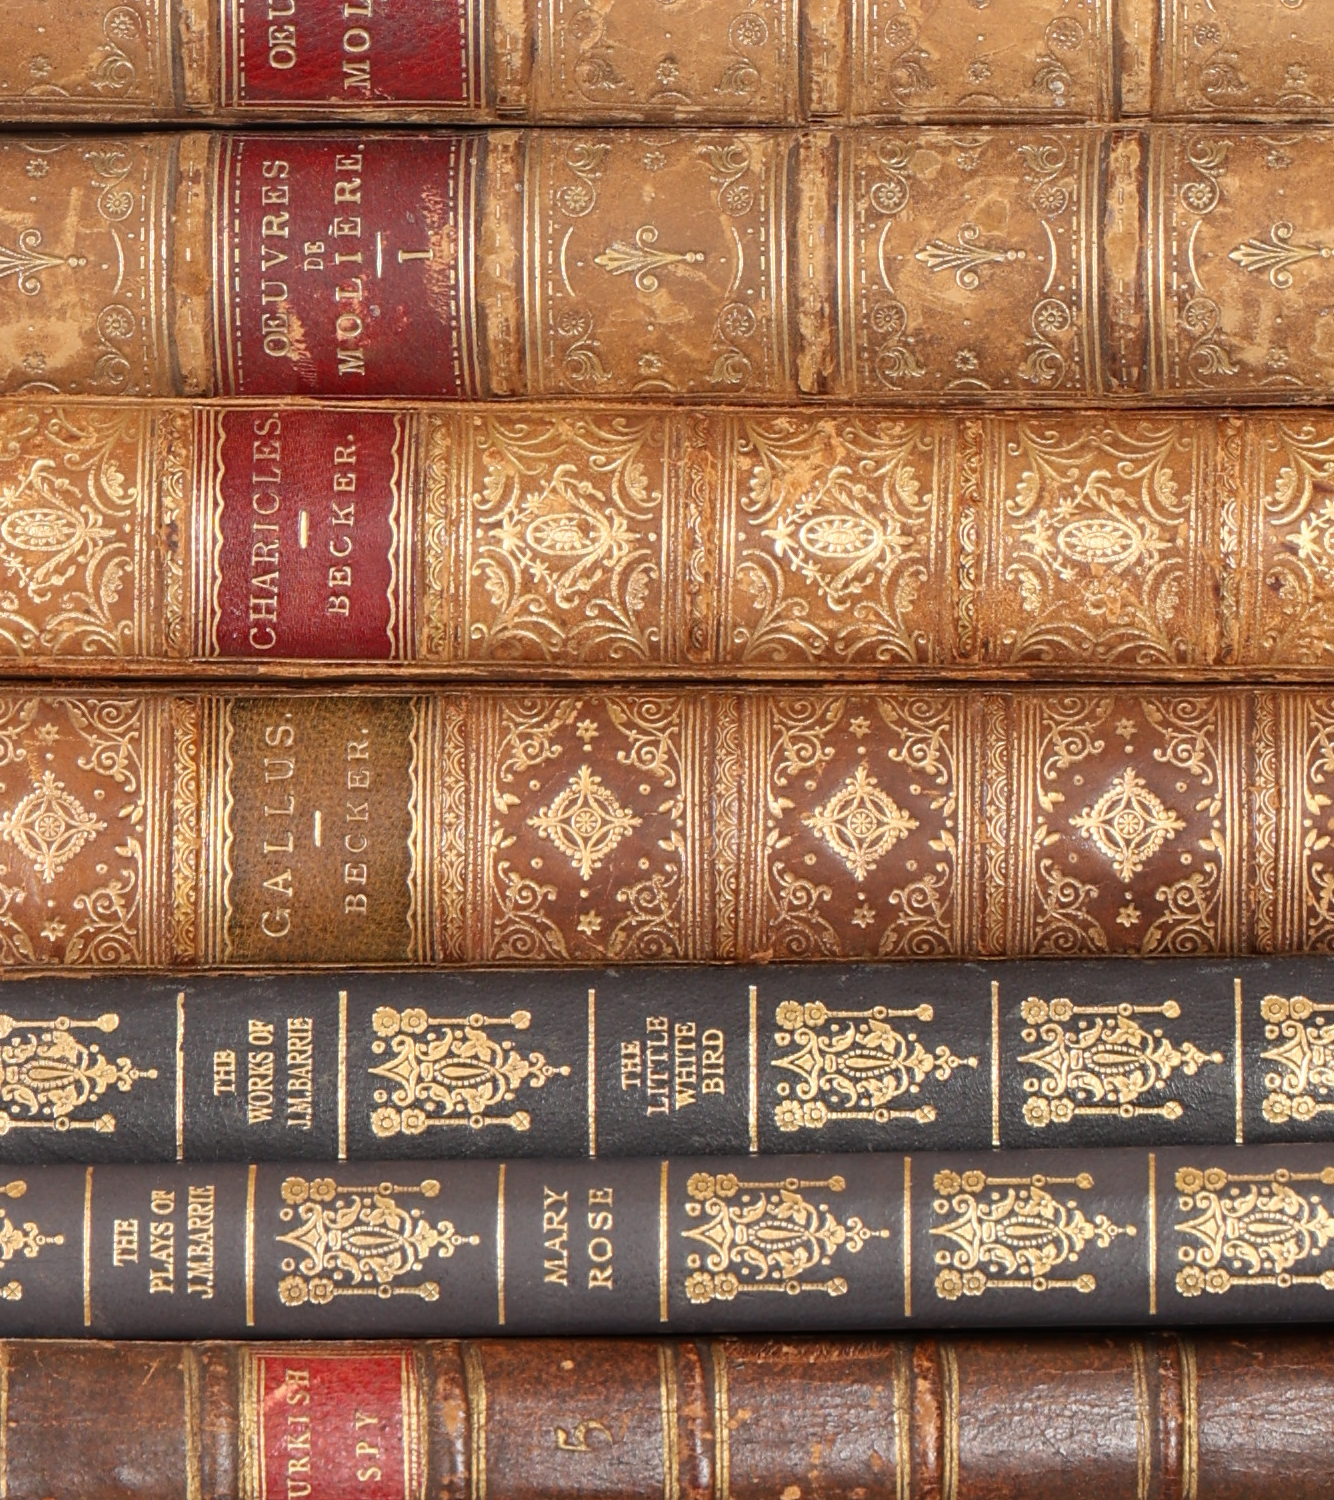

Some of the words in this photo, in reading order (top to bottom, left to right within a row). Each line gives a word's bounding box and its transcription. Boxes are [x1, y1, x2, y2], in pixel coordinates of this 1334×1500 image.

[304, 241, 325, 271] DE
[250, 412, 282, 650] CHARICLES.
[328, 434, 357, 616] BECKER.
[262, 712, 295, 938] GALLUS.
[345, 728, 370, 914] BECKER.
[249, 1019, 273, 1046] OF
[621, 1040, 642, 1090] THE
[646, 1015, 671, 1115] LITTLE
[676, 1021, 697, 1110] WHITE
[701, 1029, 725, 1094] BIRD
[214, 1049, 236, 1096] THE
[249, 1051, 274, 1123] WORKS
[151, 1190, 173, 1215] OF
[544, 1186, 569, 1286] MARY
[588, 1187, 614, 1290] ROSE
[114, 1219, 138, 1266] THE
[150, 1222, 175, 1294] PLAYS
[355, 1409, 382, 1482] SPY
[554, 1420, 613, 1451] 5
